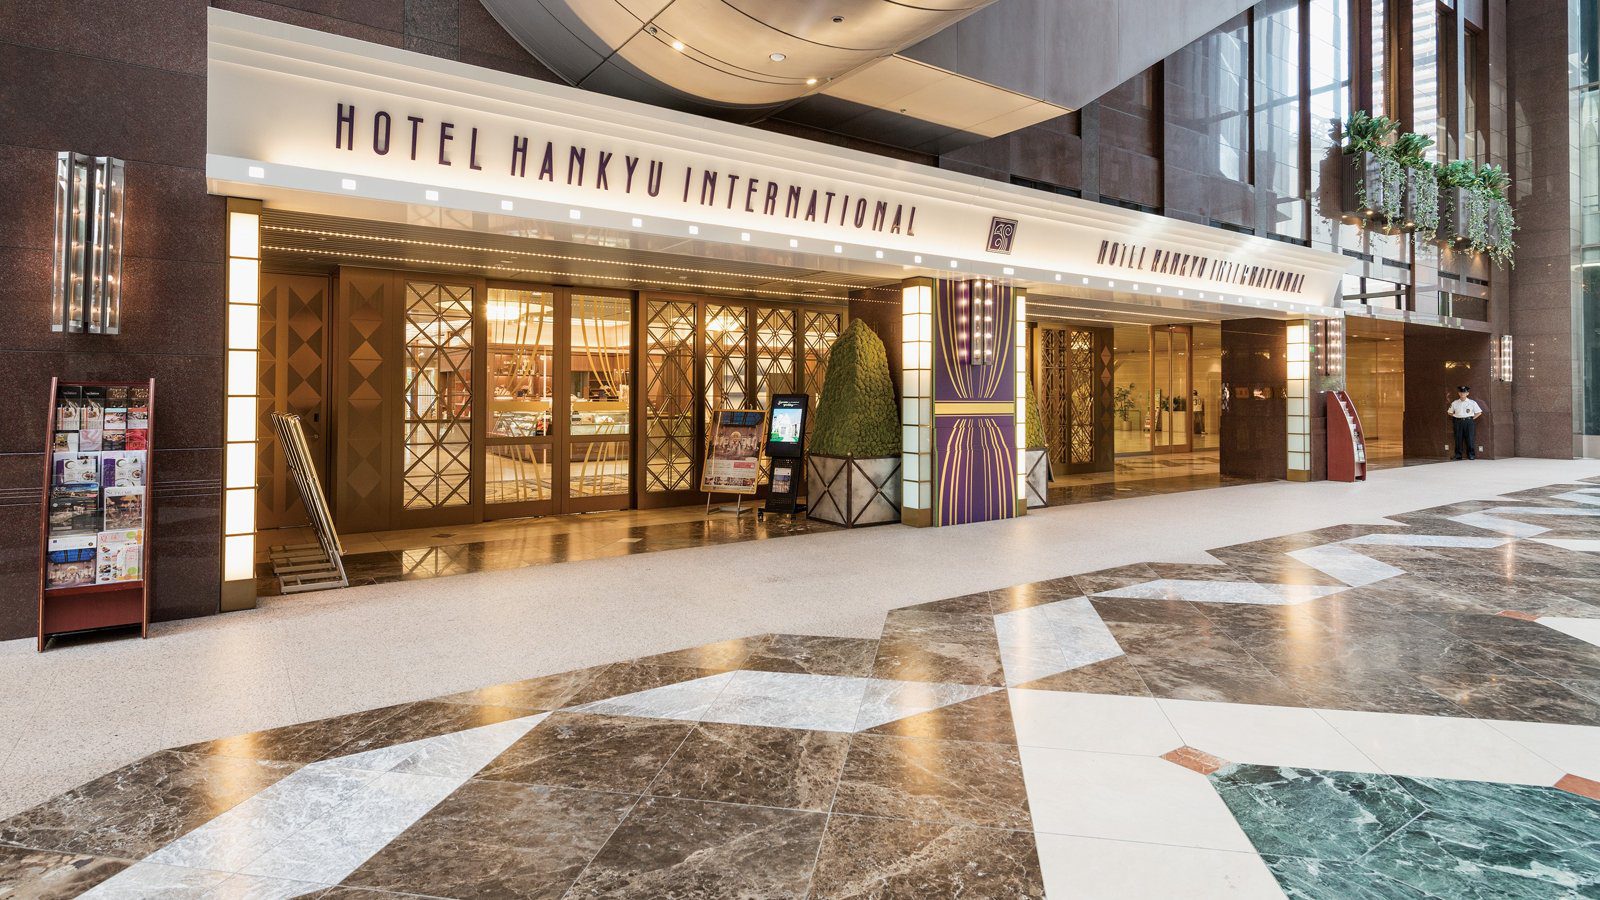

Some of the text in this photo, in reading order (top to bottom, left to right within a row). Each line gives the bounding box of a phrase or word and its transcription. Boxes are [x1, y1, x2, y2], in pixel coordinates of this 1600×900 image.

[335, 102, 917, 237] HOTEL HANKYU INTERNATIONAL
[1096, 239, 1306, 294] HOTEL HANKYU INTERNATIONAL
